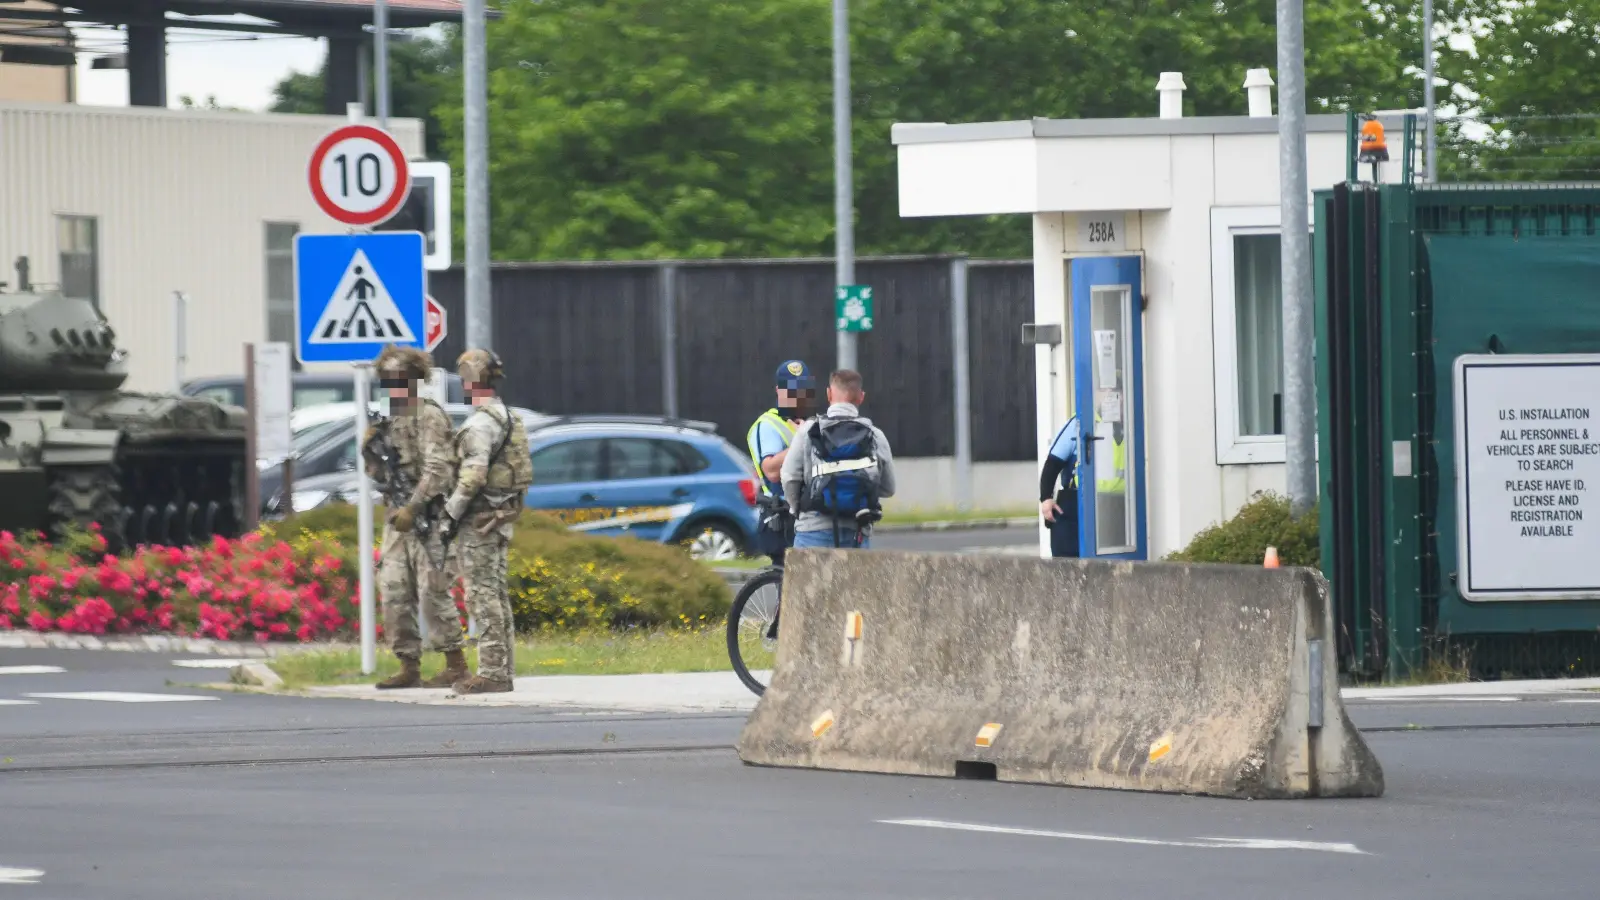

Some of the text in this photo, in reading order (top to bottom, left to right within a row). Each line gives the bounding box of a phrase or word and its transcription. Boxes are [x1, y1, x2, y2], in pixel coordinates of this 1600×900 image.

[334, 152, 381, 197] 10
[1088, 221, 1115, 242] 258A
[1499, 408, 1590, 420] U.S. INSTALLATION
[1500, 428, 1589, 441] ALL PERSONNEL &
[1486, 444, 1535, 456] VEHICLES
[1537, 444, 1557, 455] ARE
[1517, 459, 1574, 471] TO SEARCH
[1505, 479, 1587, 492] PLEASE HAVE ID,
[1513, 494, 1580, 507] LICENSE AND
[1510, 510, 1583, 522] REGISTRATION
[1520, 525, 1574, 537] AVAILABLE
